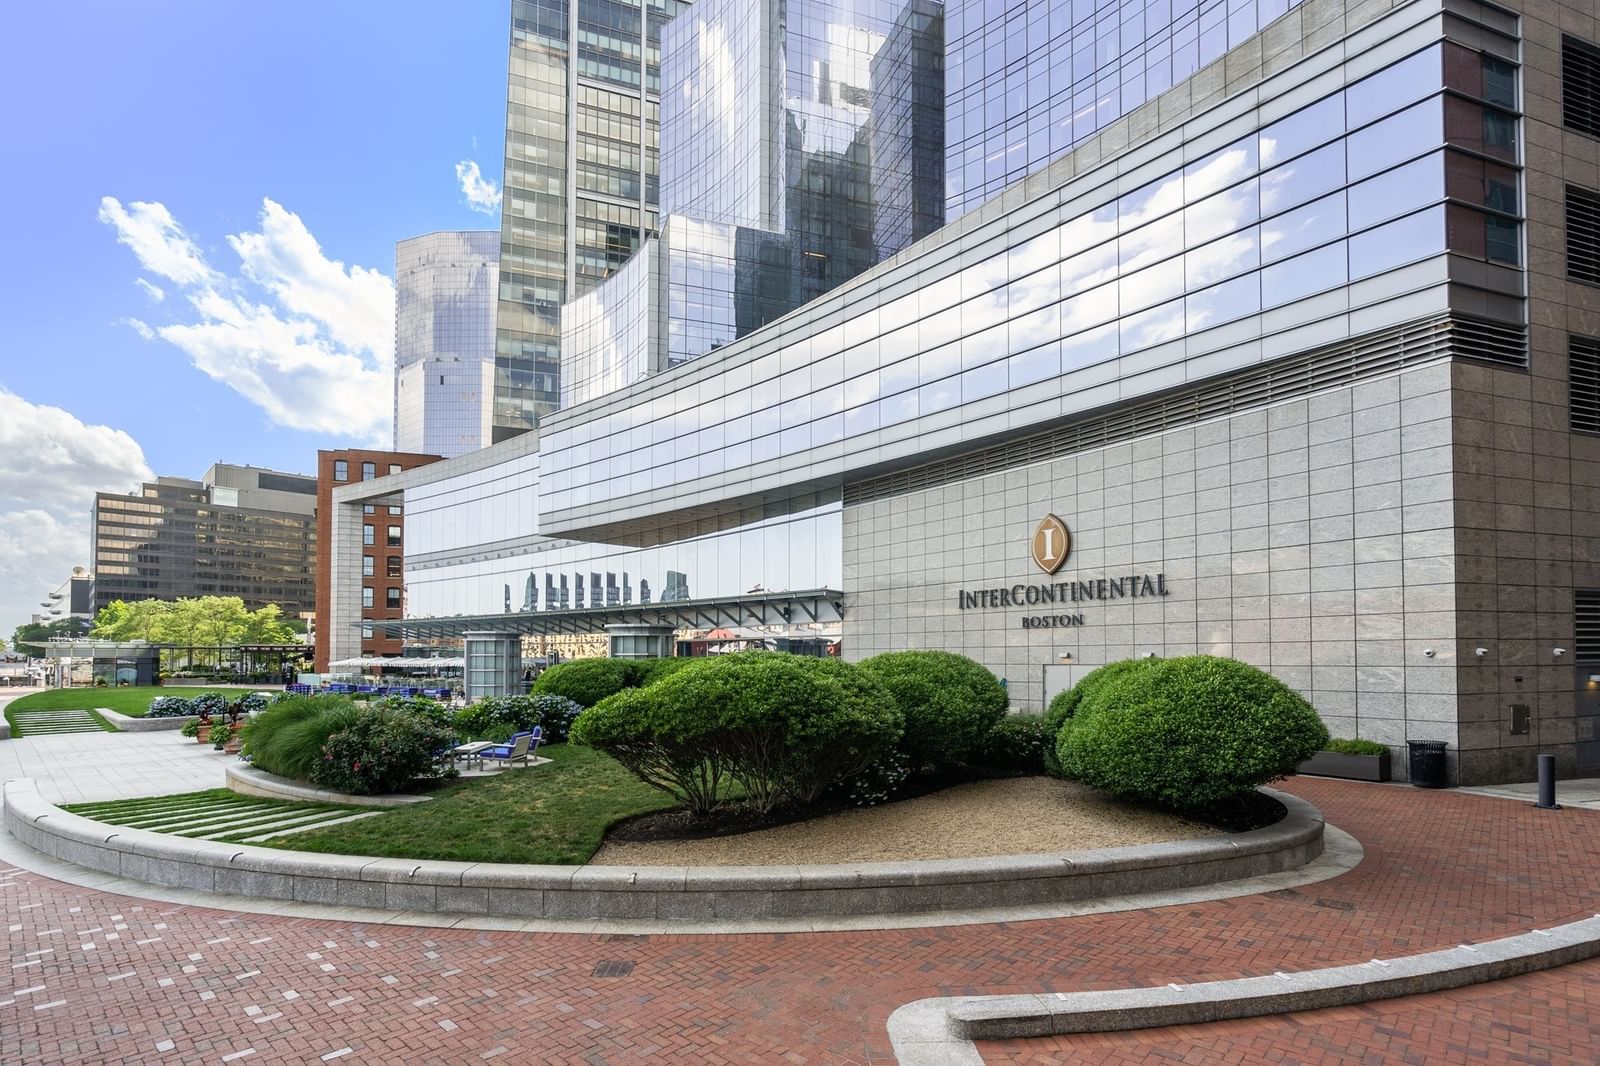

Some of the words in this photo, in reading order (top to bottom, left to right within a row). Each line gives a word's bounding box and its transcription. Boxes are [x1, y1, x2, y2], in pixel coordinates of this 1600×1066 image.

[1041, 527, 1057, 561] I
[958, 573, 1169, 610] INTERCONTINENTAL
[1022, 614, 1084, 629] BOSTON
